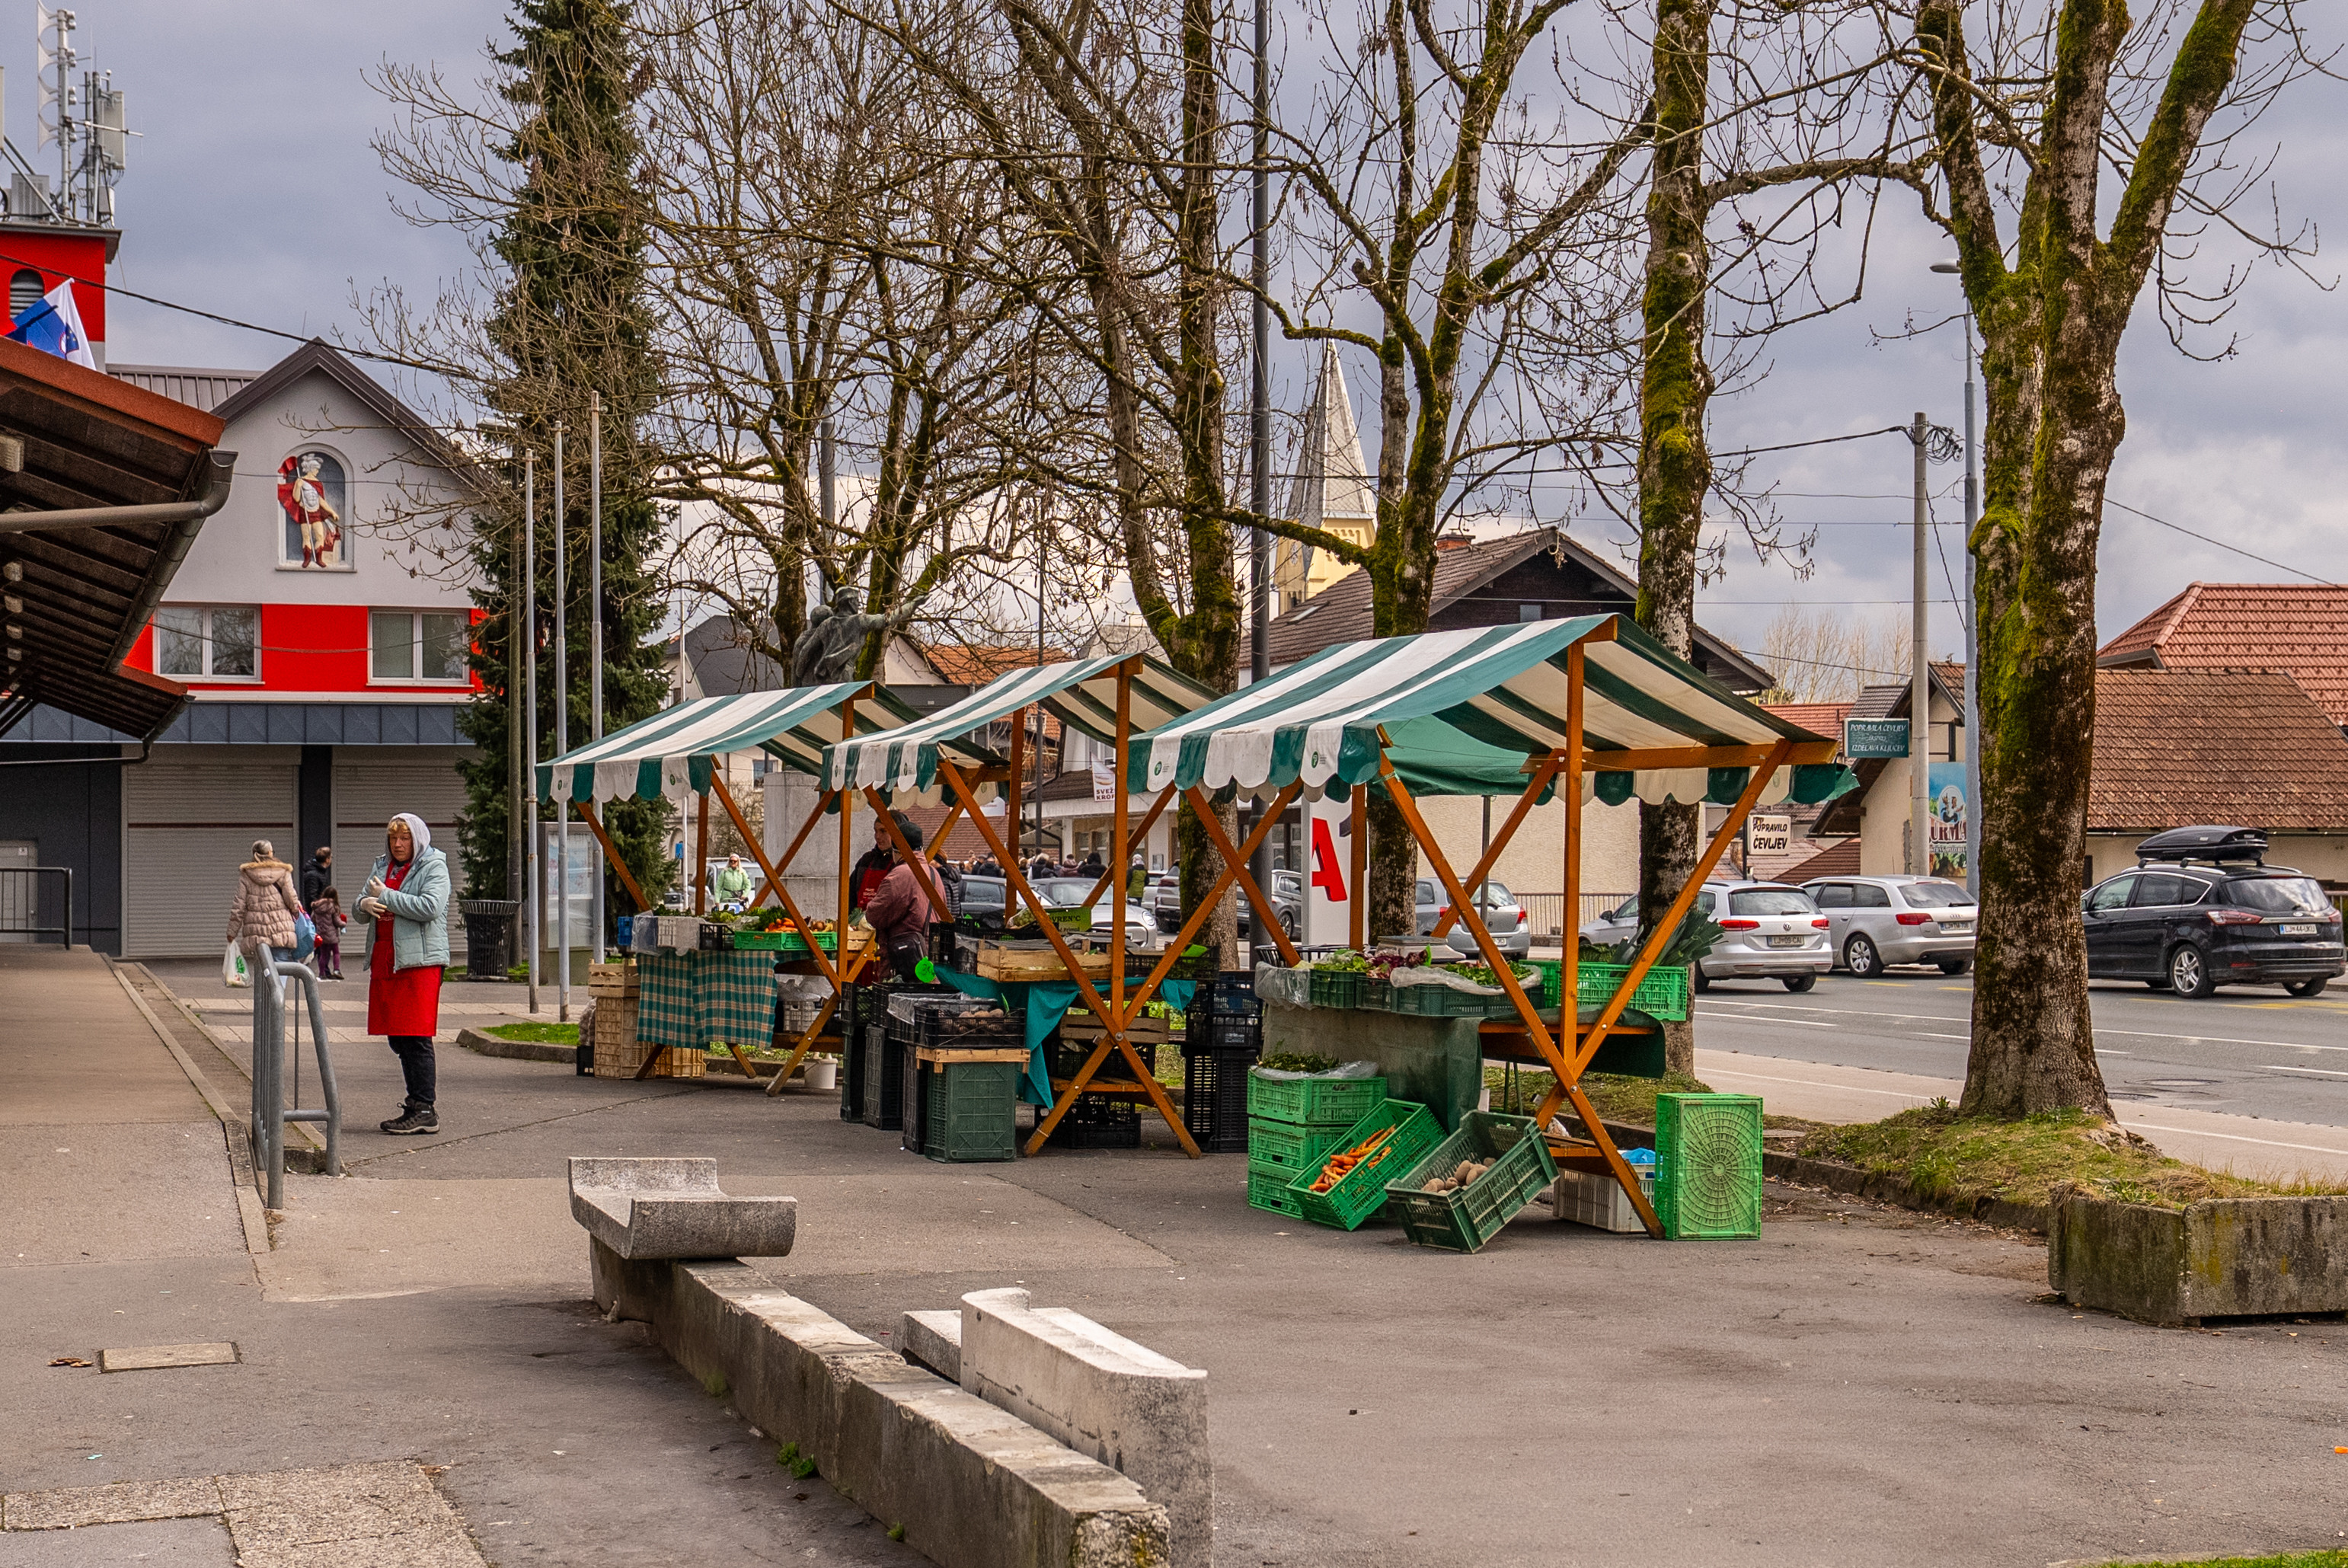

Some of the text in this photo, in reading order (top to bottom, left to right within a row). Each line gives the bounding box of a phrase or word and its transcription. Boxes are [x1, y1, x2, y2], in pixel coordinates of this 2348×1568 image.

[1850, 723, 1906, 733] POPRAVILA ČEVLJEV
[1880, 744, 1905, 753] KLJUČEV
[1752, 823, 1787, 832] POPRAVILO
[1928, 821, 1966, 842] URMA
[1753, 835, 1788, 850] ČEVLJEV
